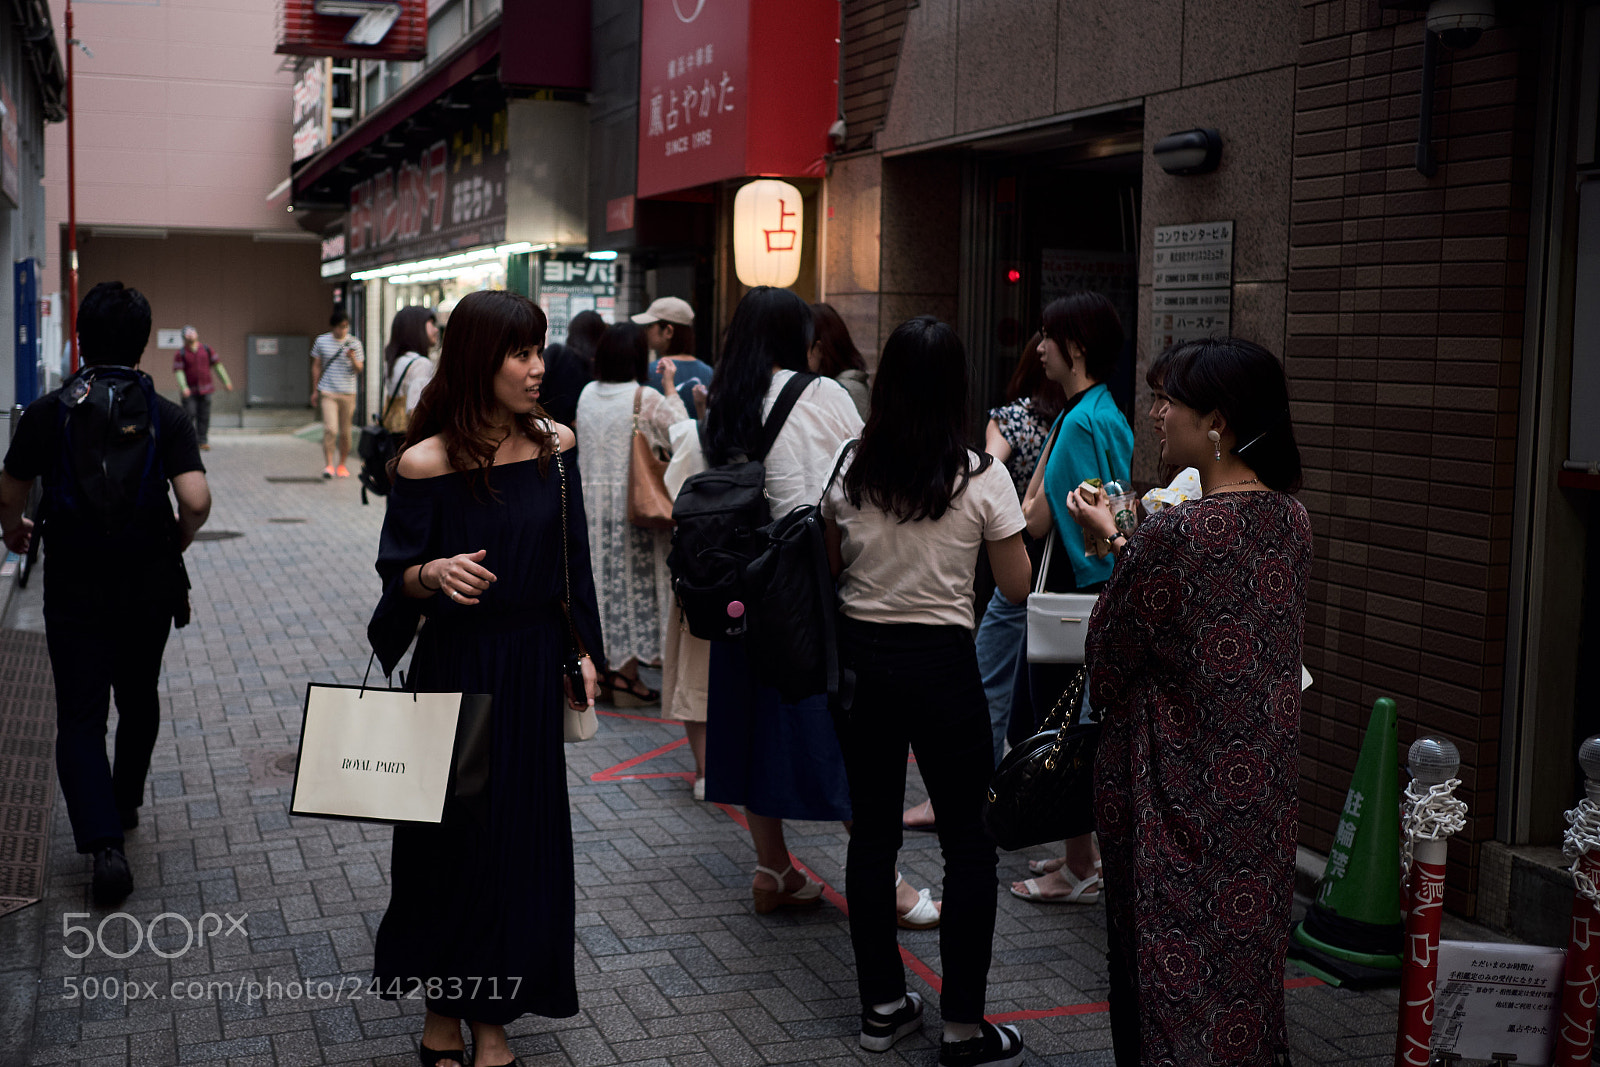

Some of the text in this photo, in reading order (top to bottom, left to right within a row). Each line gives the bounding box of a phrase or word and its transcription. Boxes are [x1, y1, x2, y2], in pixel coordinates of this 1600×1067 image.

[648, 70, 736, 137] 鳳占やかた
[664, 135, 690, 157] SINCE
[763, 198, 797, 254] 占
[1157, 225, 1230, 243] コンワセンタービル
[341, 758, 406, 774] ROYAL PARTY
[1470, 959, 1535, 972] ただいまのお時間は
[1449, 970, 1549, 986] 手相鑑定のみの受付になります
[1506, 1024, 1549, 1036] 鳳占やかた
